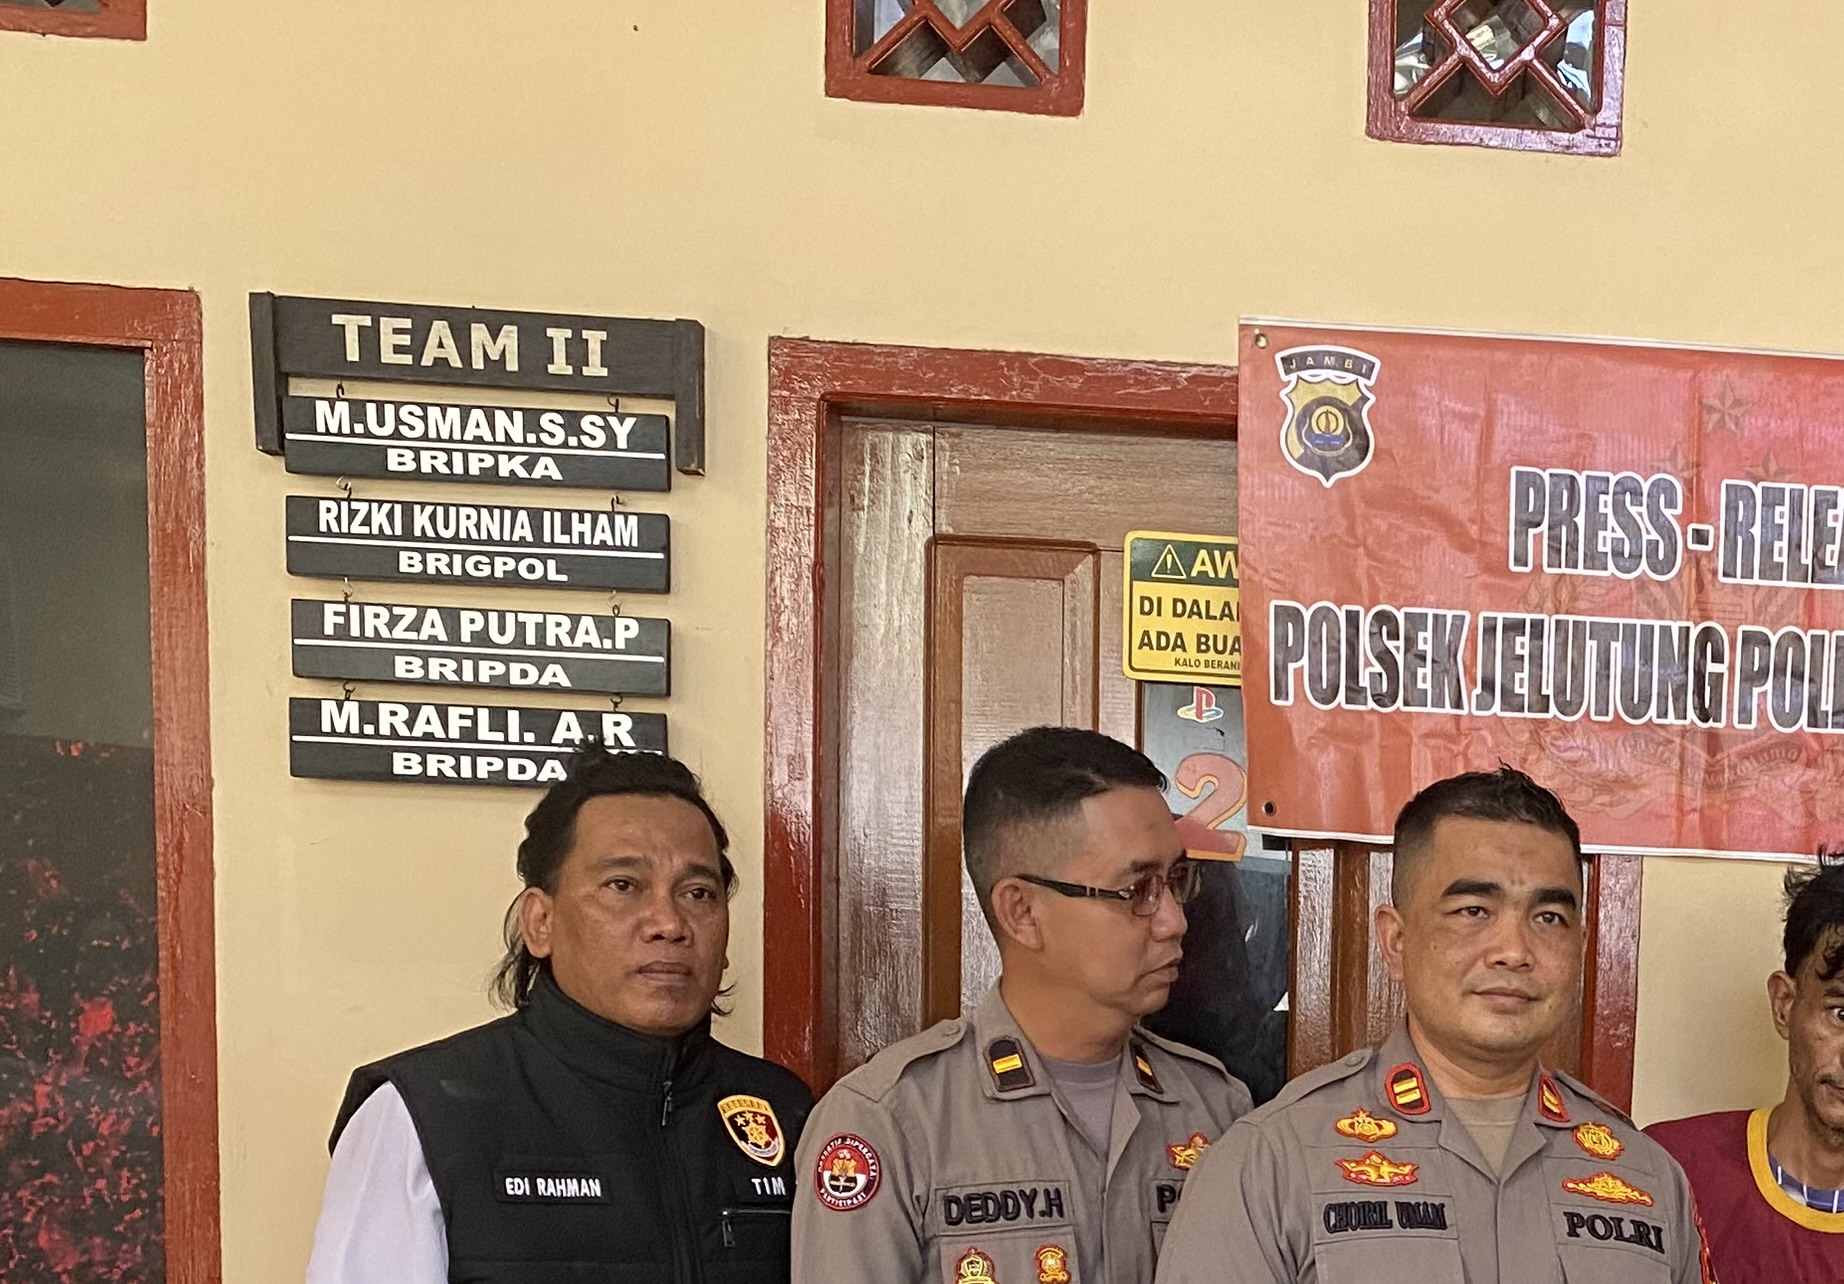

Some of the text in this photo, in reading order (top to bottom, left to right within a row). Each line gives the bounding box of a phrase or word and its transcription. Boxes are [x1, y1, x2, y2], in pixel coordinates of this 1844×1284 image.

[331, 314, 608, 377] TEAM II
[1289, 356, 1367, 374] JAMBI
[315, 400, 637, 450] M.USMAN.S.SY
[386, 447, 564, 481] BRIPKA
[318, 500, 639, 548] RIZKI KURNIA ILHAM
[1509, 466, 1683, 581] PRESS
[398, 551, 569, 582] BRIGPOL
[1139, 595, 1240, 623] DI DALA
[323, 603, 640, 650] FIRZA PUTRA.P
[1137, 629, 1187, 653] ADA
[394, 655, 572, 688] BRIPDA
[1174, 657, 1201, 668] KALO
[1269, 600, 1470, 715] POLSEK
[1471, 610, 1729, 728] JELUTUNG
[392, 751, 568, 782] BRIPDA
[505, 1177, 602, 1198] EDI RAHMAN
[751, 1176, 786, 1196] TIM
[944, 1187, 1065, 1226] DEDDY.H
[1562, 1210, 1665, 1255] POLRI
